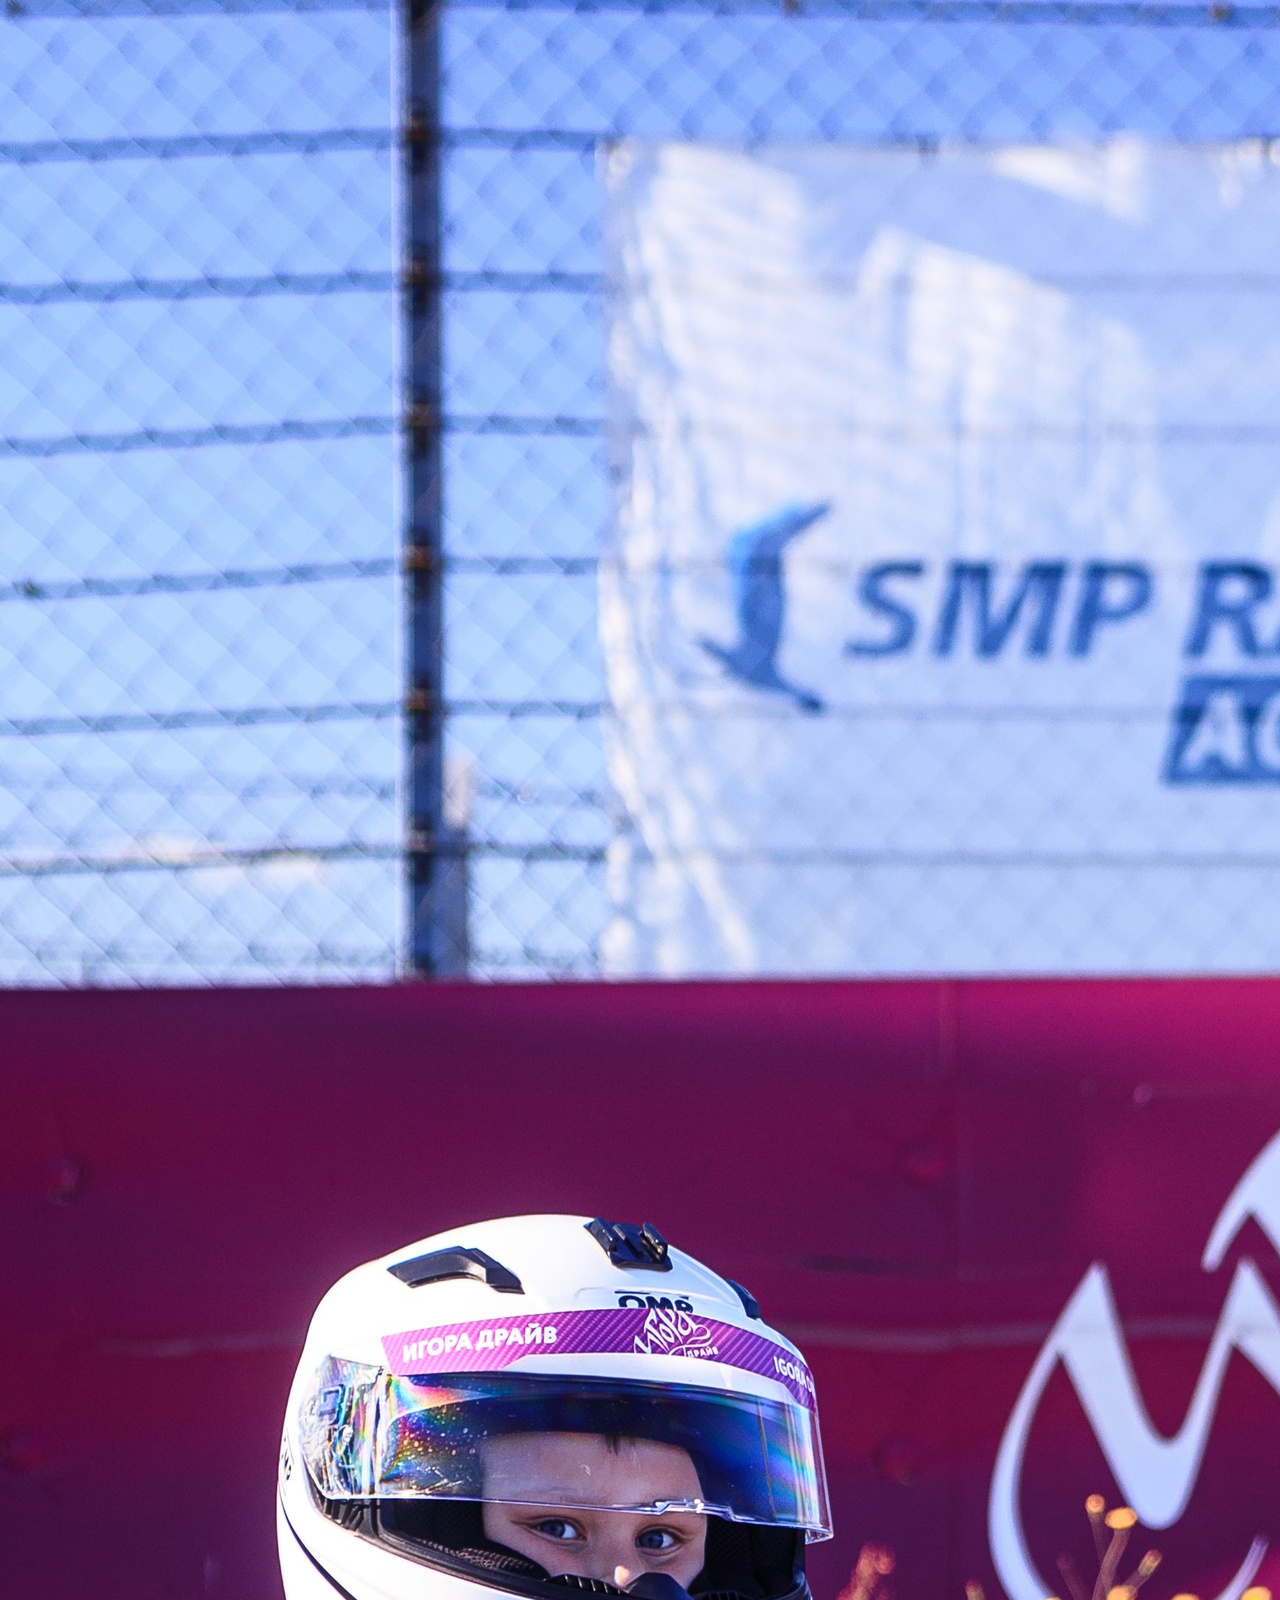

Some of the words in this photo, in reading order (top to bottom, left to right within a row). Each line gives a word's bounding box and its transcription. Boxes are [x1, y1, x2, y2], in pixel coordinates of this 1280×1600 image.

[845, 557, 1154, 661] SMP
[402, 1332, 474, 1363] ИГОРА
[475, 1322, 557, 1351] ДРАЙВ
[773, 1355, 808, 1389] IGORA
